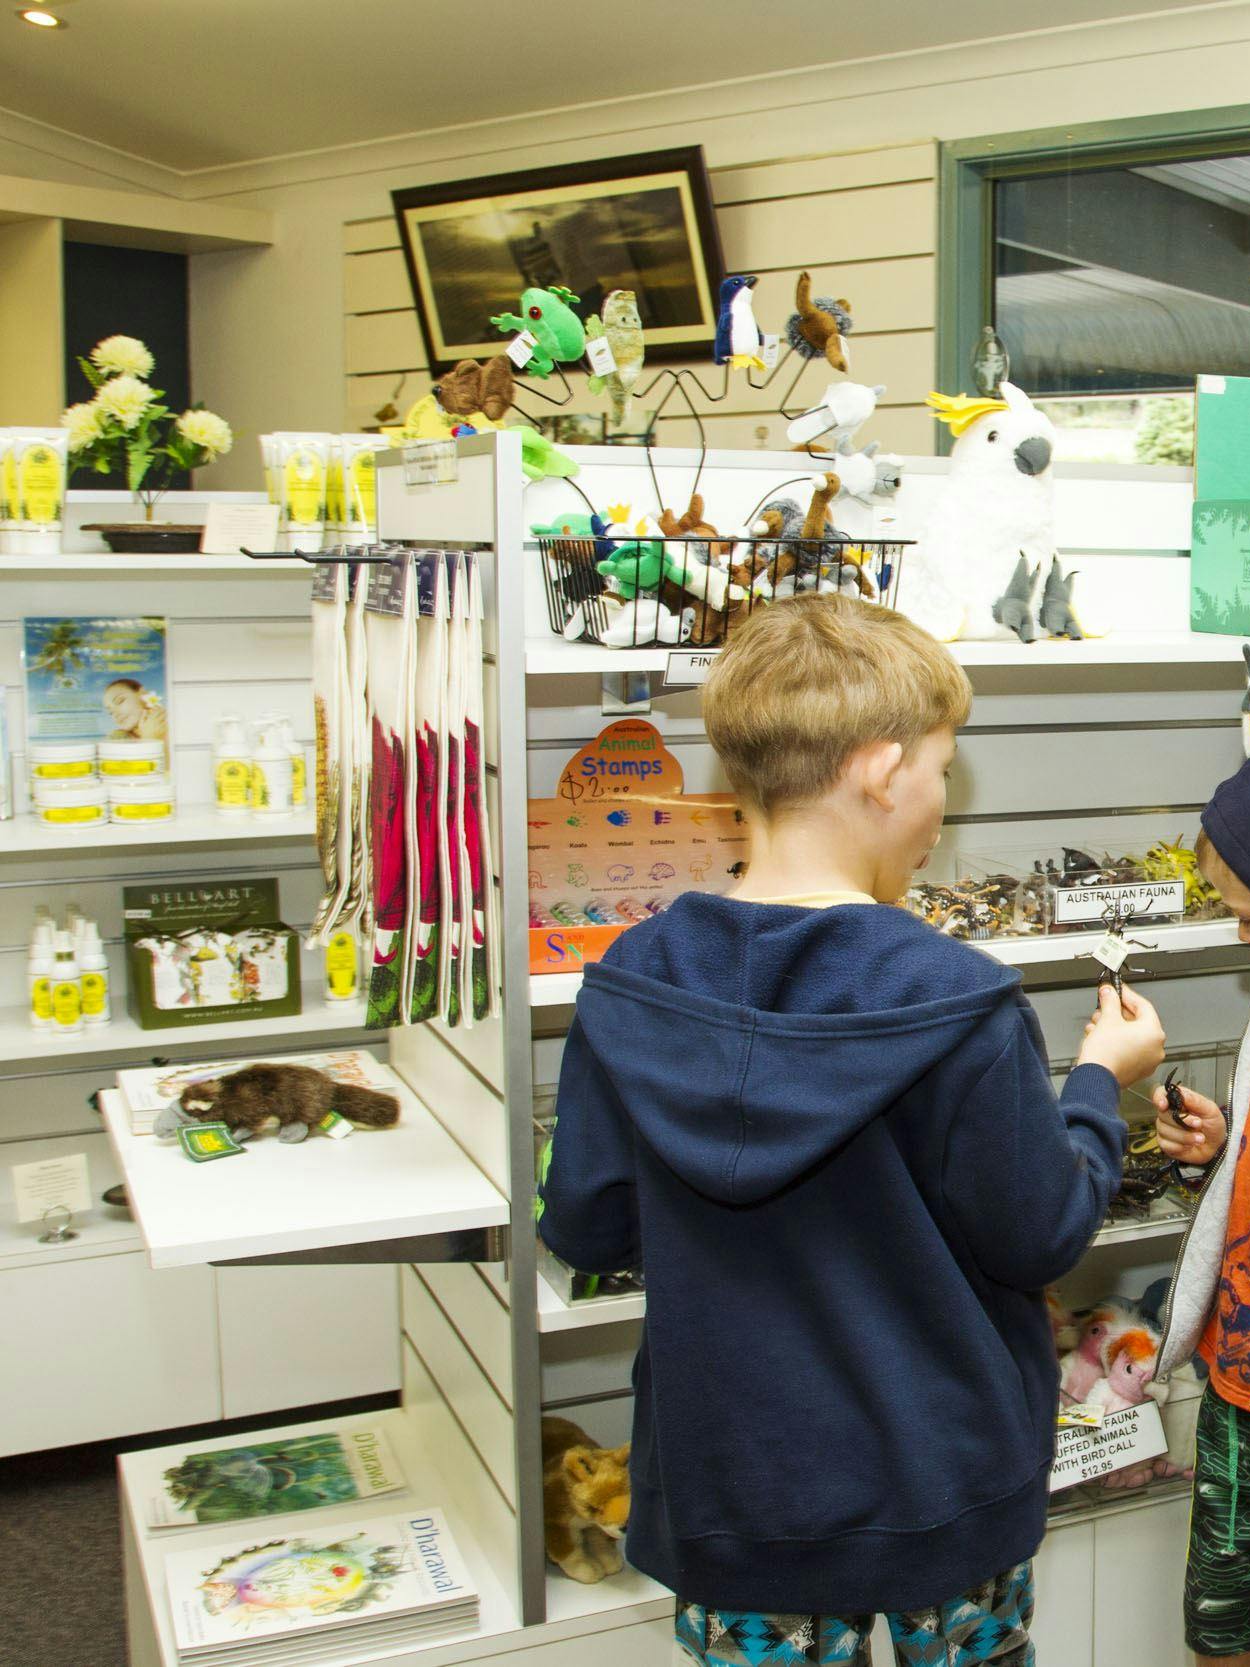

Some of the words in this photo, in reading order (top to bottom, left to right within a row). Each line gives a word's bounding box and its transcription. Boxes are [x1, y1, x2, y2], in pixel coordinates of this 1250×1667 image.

[690, 656, 712, 667] FIN
[598, 735, 657, 752] Animal
[581, 756, 663, 781] Stamps
[1066, 889, 1136, 904] AUSTRALIAN
[1139, 886, 1176, 898] FAUNA
[1055, 1425, 1102, 1444] TRALIA
[1104, 1409, 1140, 1428] FAUNA
[1055, 1439, 1091, 1458] UFFED
[1093, 1423, 1138, 1447] ANIMALS
[1051, 1458, 1079, 1474] WITH
[1081, 1448, 1107, 1465] BIRD
[1108, 1439, 1136, 1455] CALL
[1081, 1460, 1114, 1479] $12.95
[410, 1517, 464, 1593] D'harawal
